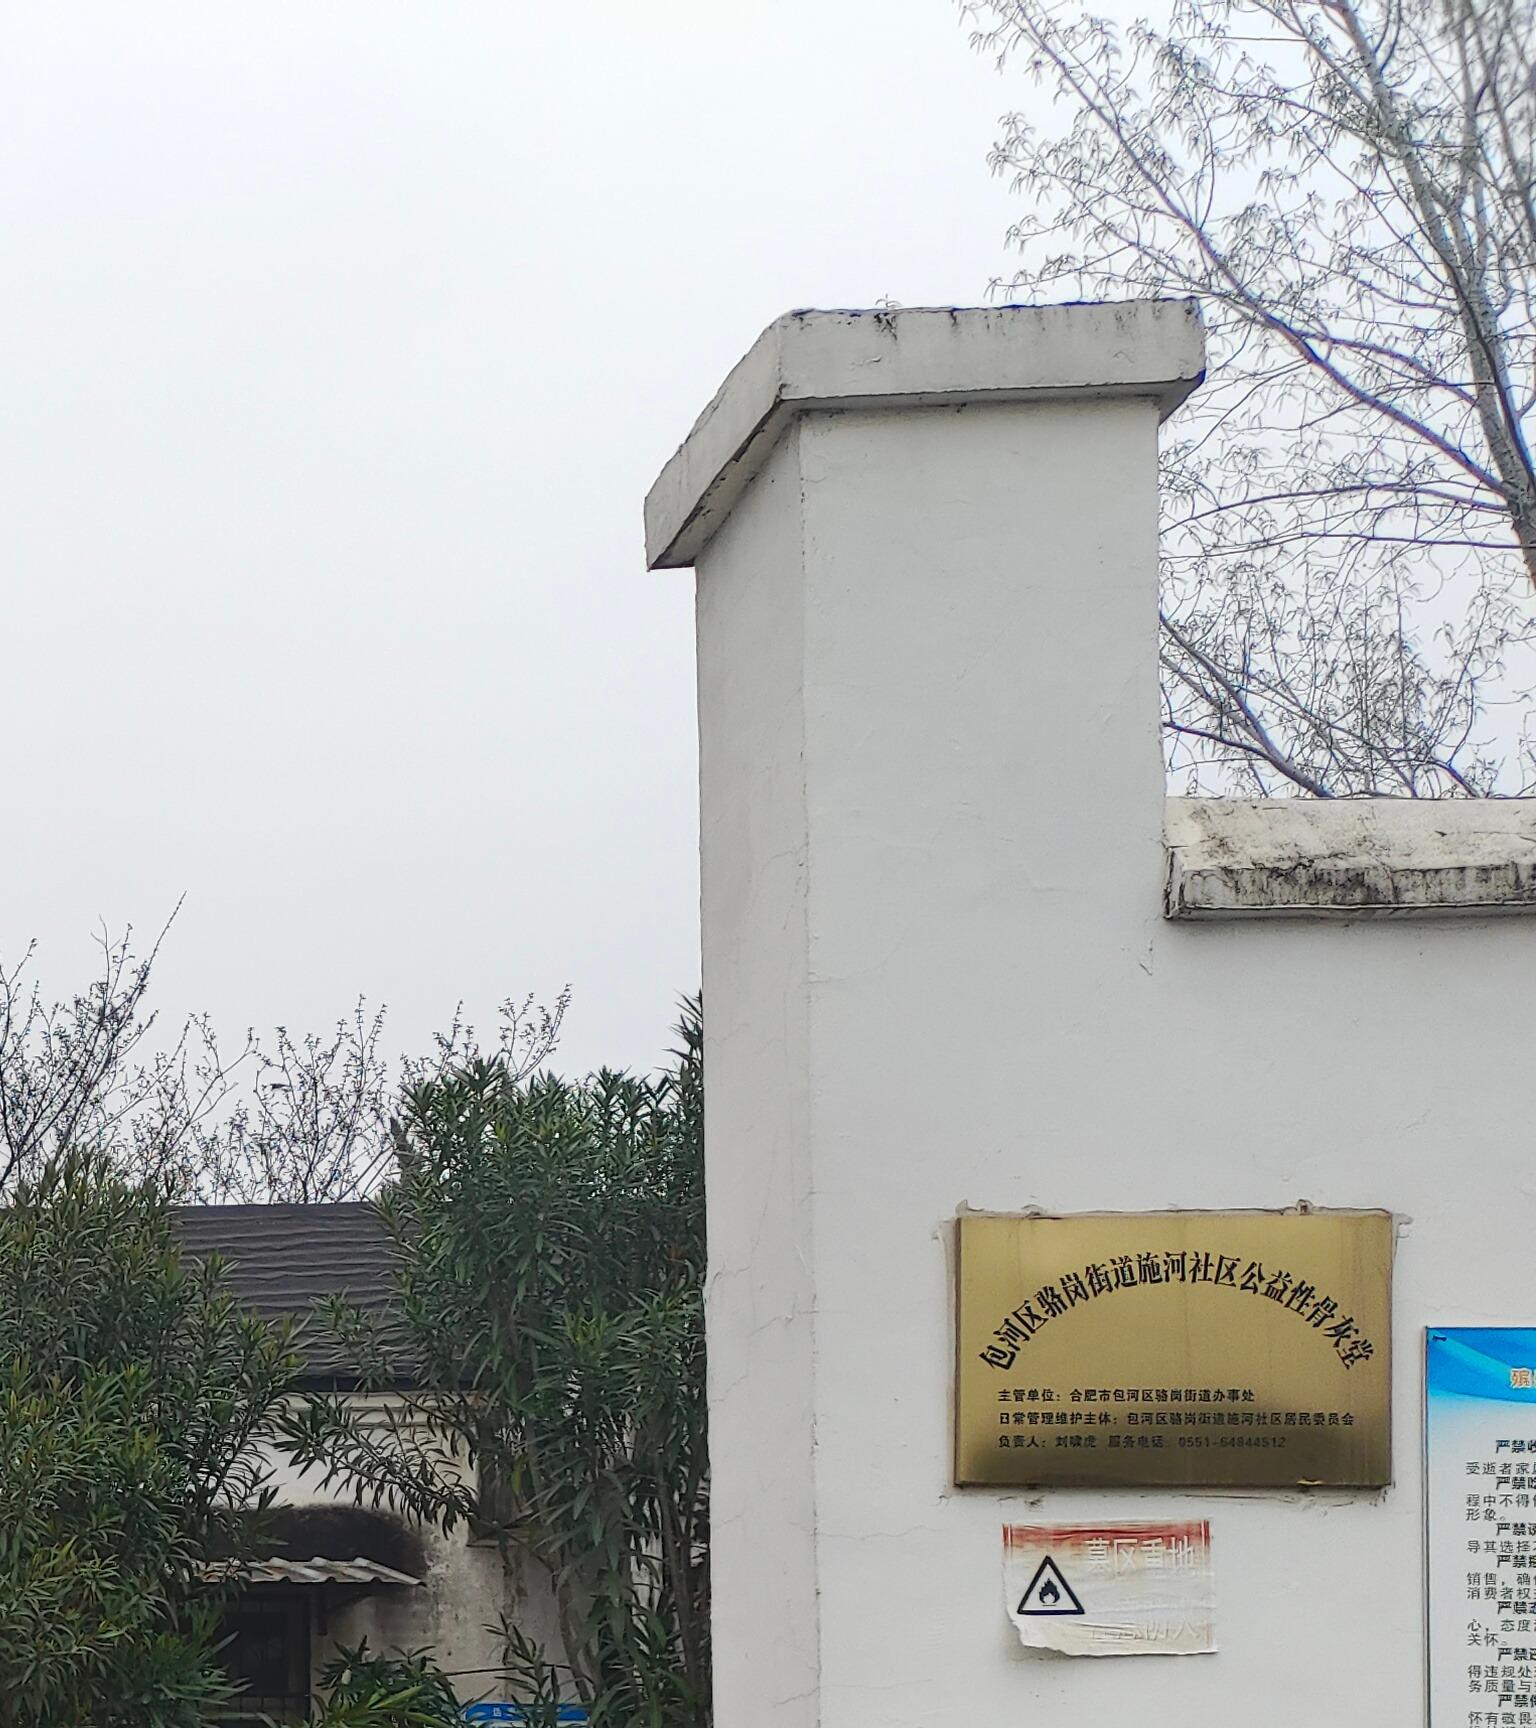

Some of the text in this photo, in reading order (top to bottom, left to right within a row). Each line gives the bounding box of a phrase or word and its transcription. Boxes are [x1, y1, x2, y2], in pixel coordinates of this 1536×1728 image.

[978, 1250, 1375, 1371] 包河区骆岗街道施河社区公益性骨灰堂
[1466, 1462, 1536, 1475] 受逝者家
[1466, 1494, 1536, 1508] 程中不得
[1467, 1541, 1536, 1554] 导其选择
[1467, 1572, 1536, 1586] 销售，确
[1467, 1586, 1536, 1600] 消费者权
[1467, 1619, 1536, 1632] 心，态度
[1468, 1665, 1536, 1679] 得违规处
[1469, 1679, 1536, 1693] 务质量与
[1468, 1711, 1536, 1726] 怀有敬畏
